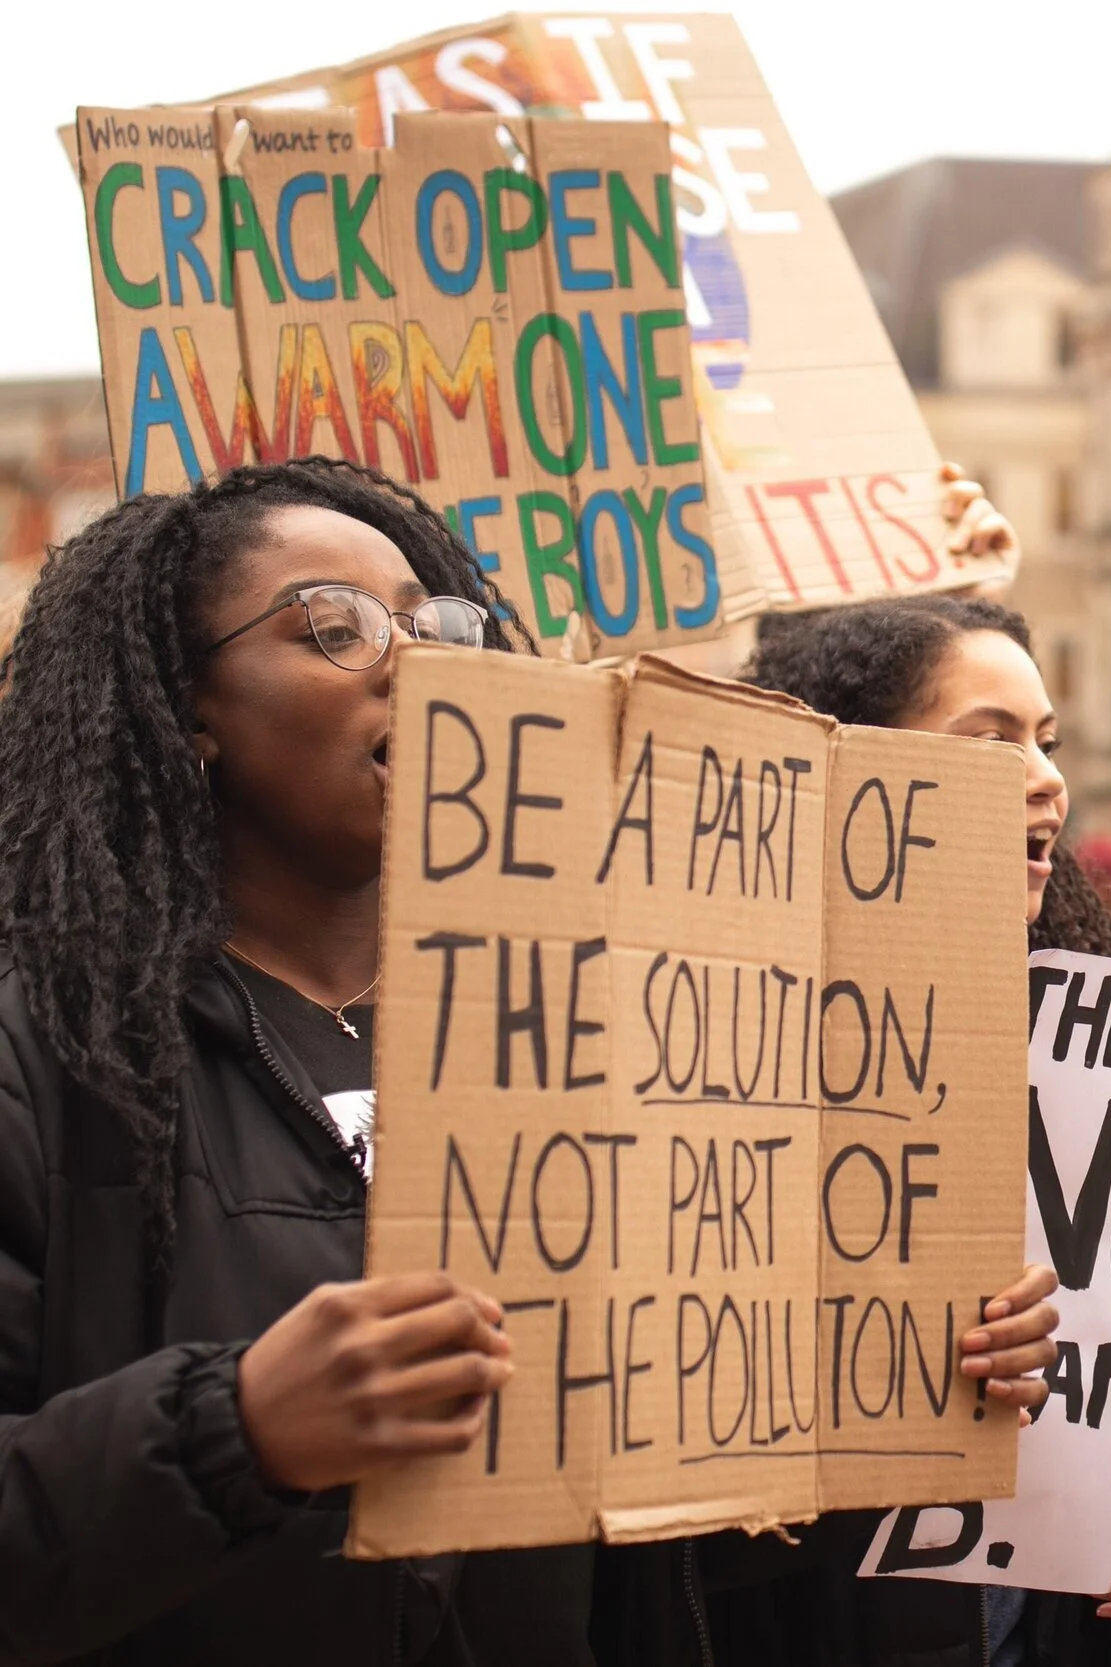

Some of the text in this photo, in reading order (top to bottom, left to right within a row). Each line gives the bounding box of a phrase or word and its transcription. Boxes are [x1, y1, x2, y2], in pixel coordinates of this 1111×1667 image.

[86, 116, 355, 153] Who would want to
[543, 18, 696, 124] IF
[94, 161, 397, 309] CRACK
[415, 166, 680, 297] OPEN
[124, 309, 701, 497] A WARM ONE
[516, 482, 721, 638] BOYS
[744, 478, 853, 603] IT
[422, 700, 940, 904] BE A PART OF
[415, 930, 949, 1116] THE SOLUTION,
[439, 1131, 941, 1277] NOT PART OF
[485, 1294, 657, 1475] THE
